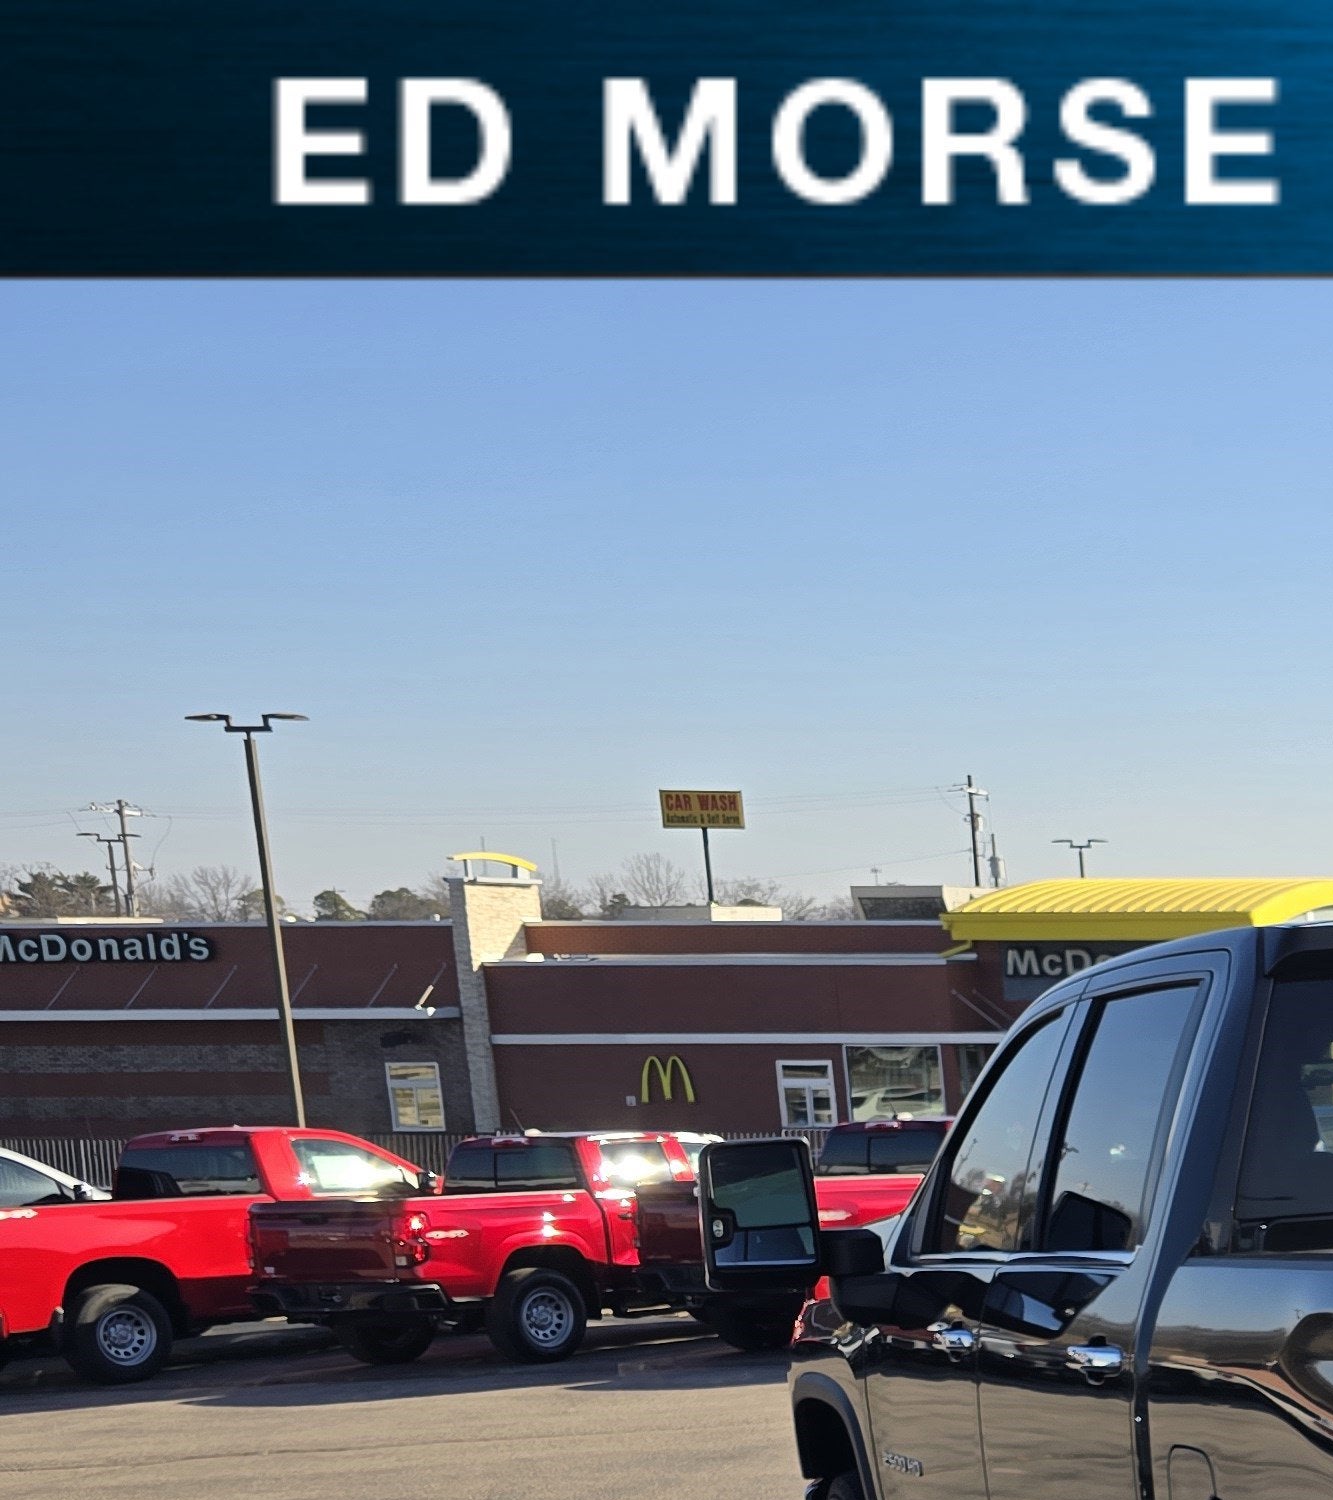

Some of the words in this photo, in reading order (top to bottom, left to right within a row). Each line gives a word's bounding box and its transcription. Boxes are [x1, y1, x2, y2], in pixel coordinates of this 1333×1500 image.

[664, 793, 693, 812] CAR
[697, 793, 739, 812] WASH
[0, 933, 210, 962] McDonald's
